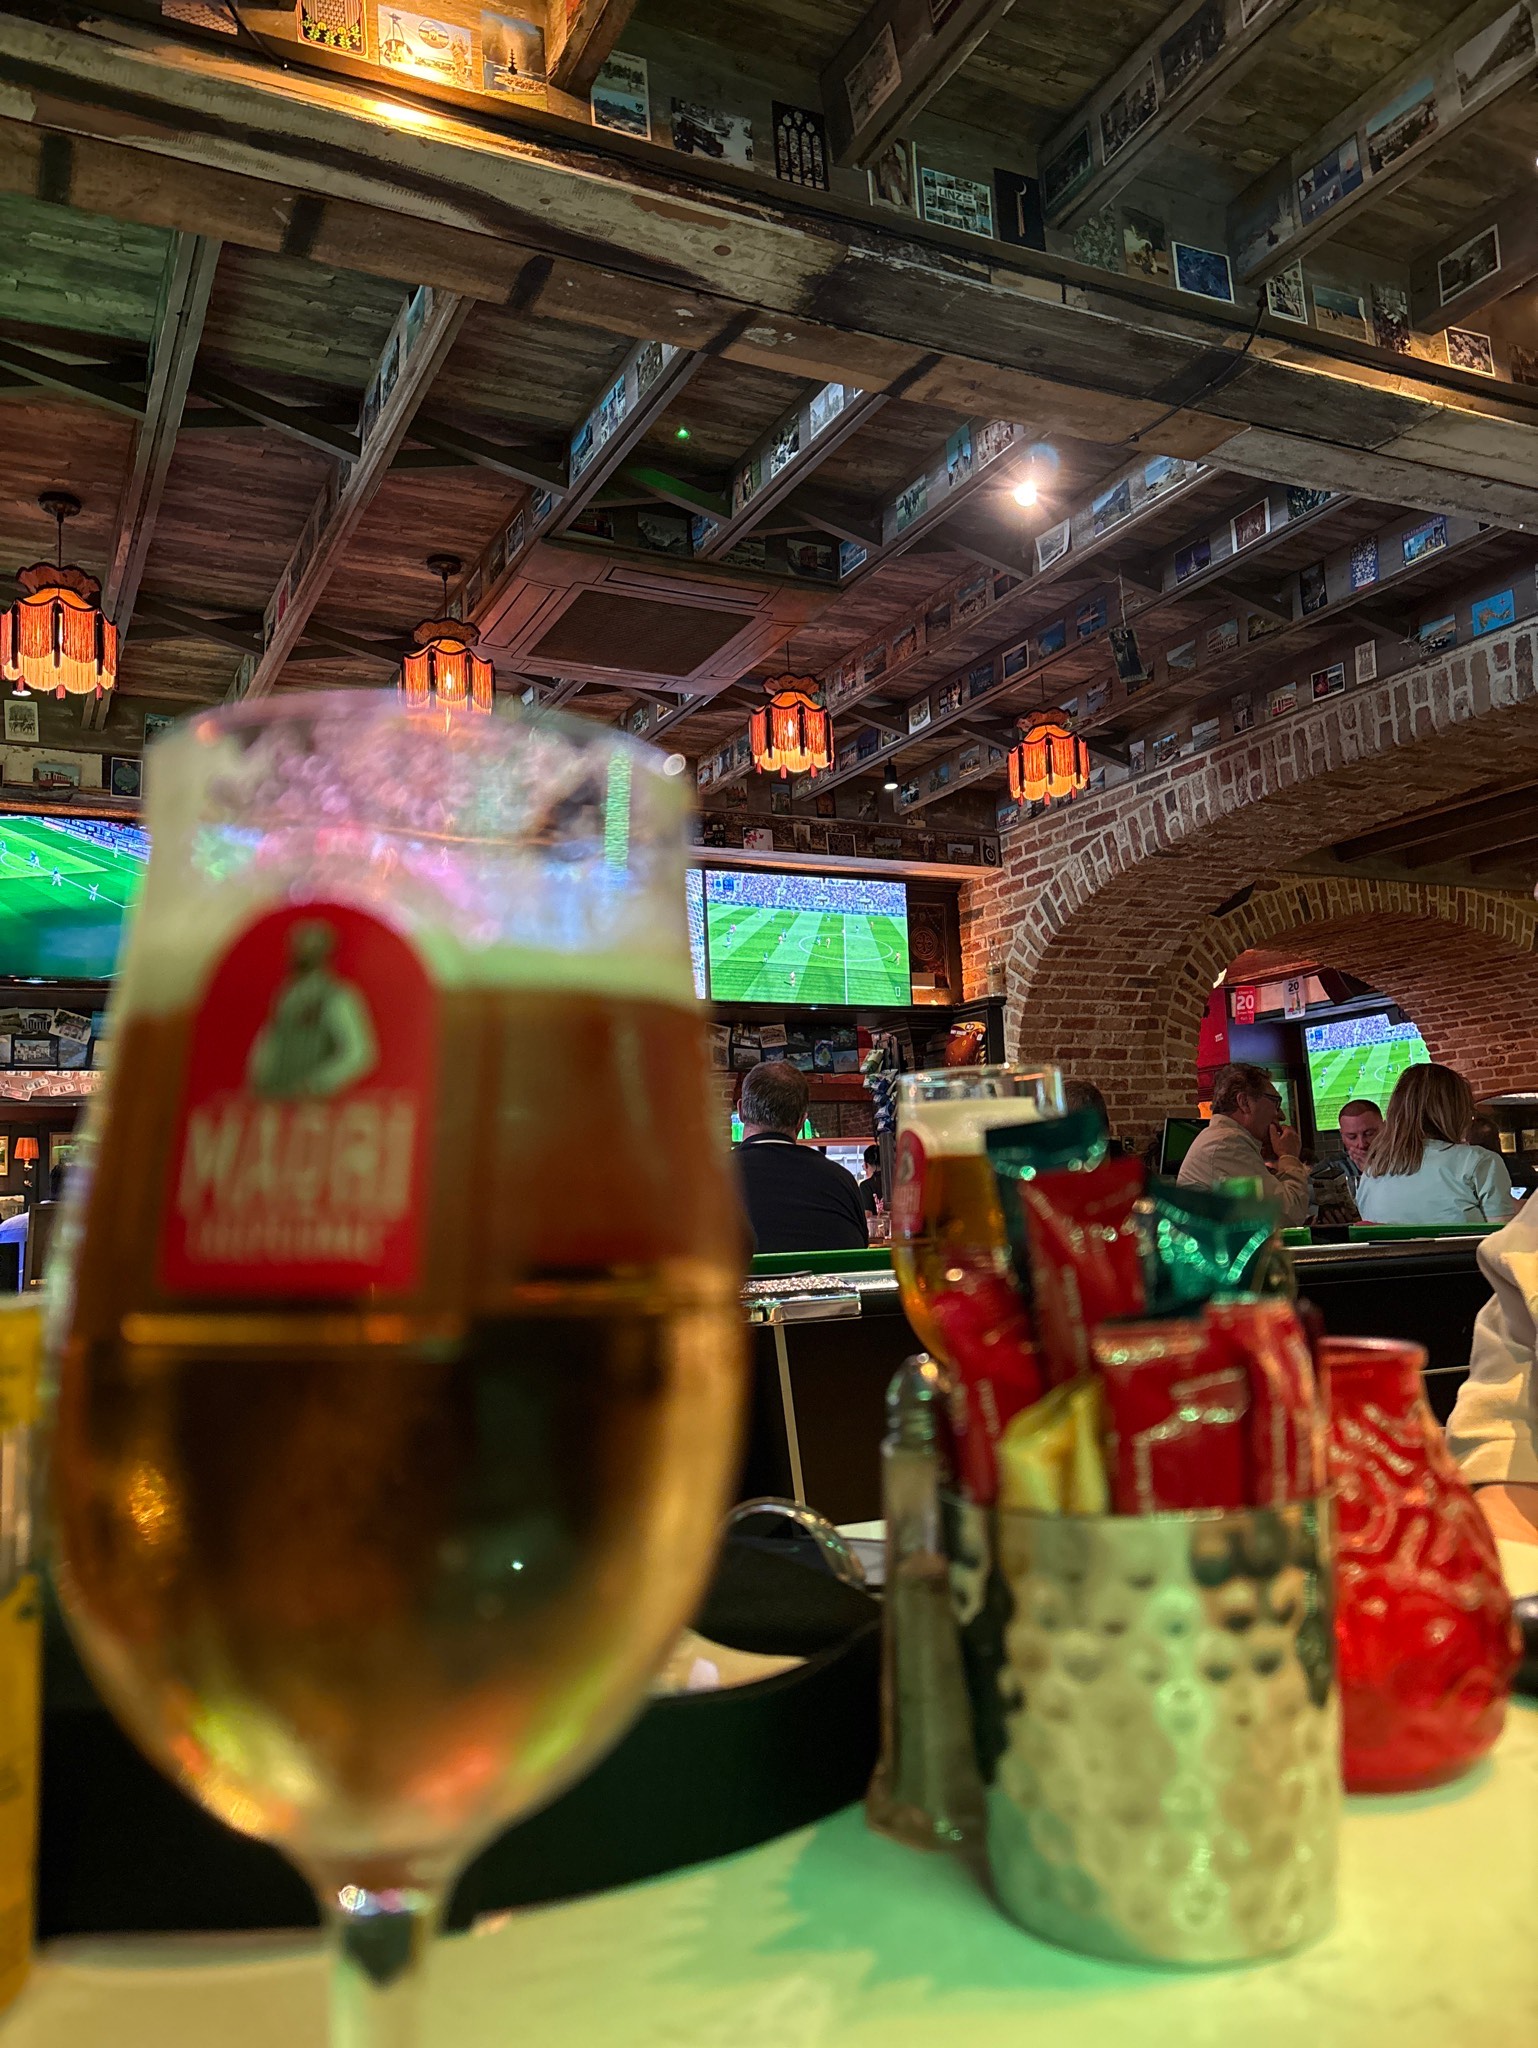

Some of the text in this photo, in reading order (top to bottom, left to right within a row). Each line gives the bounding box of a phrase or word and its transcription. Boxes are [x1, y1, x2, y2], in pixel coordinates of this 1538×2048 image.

[939, 187, 963, 202] LINZ
[1288, 982, 1300, 992] 20
[1236, 994, 1255, 1011] 20
